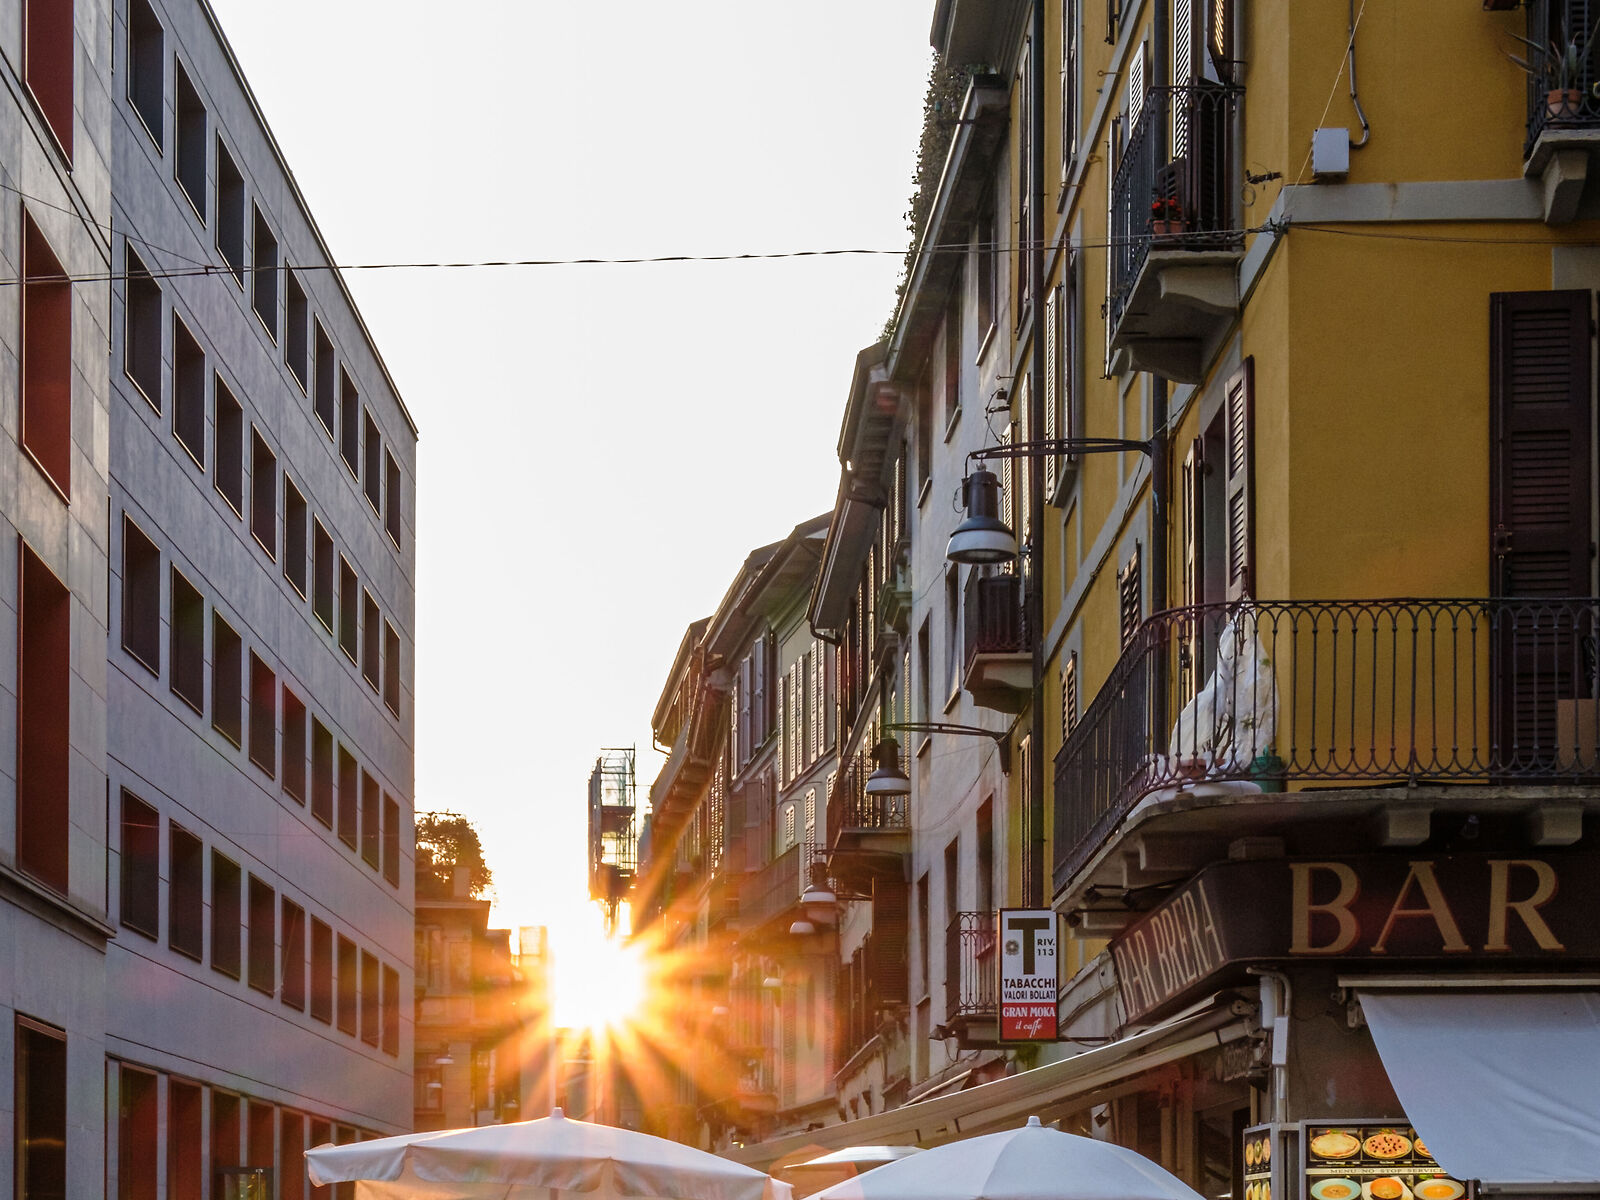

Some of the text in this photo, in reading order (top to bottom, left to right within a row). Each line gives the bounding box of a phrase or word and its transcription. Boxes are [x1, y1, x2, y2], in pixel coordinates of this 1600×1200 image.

[1288, 859, 1566, 954] BAR
[1008, 918, 1049, 974] T
[1114, 879, 1225, 1018] BAR BRERA
[1037, 948, 1054, 956] 113
[1004, 978, 1055, 989] TABACCHI
[1004, 990, 1056, 1000] VALORI BOLLATI
[1003, 1006, 1056, 1017] GRAN MOKA
